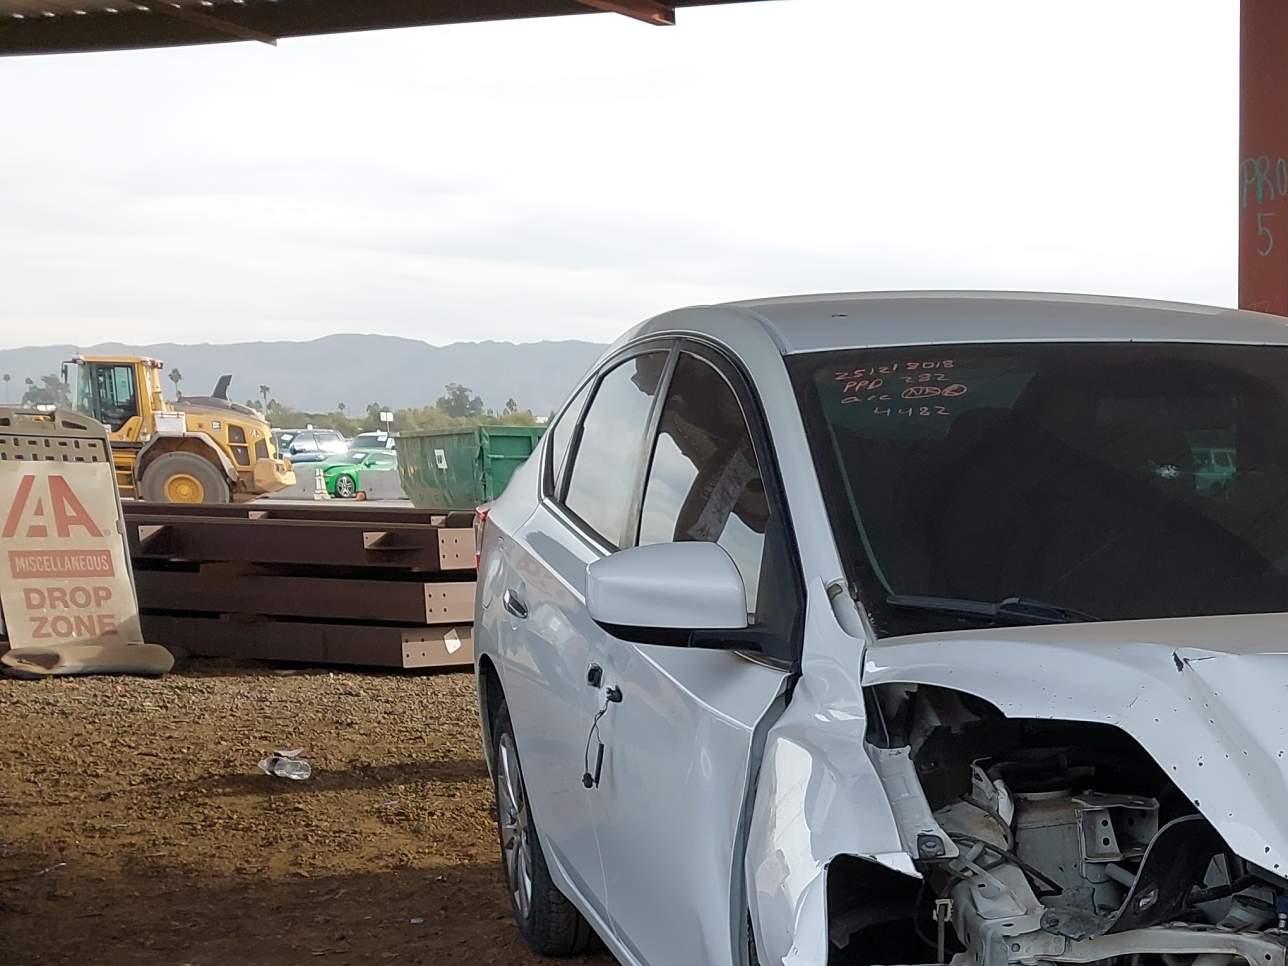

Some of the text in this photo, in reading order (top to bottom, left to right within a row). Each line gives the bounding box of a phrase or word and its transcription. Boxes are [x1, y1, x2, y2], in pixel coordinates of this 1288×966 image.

[1256, 212, 1275, 257] 5
[14, 555, 109, 573] MISCELLANEOUS
[23, 586, 112, 610] DROP
[29, 614, 118, 638] ZONE
